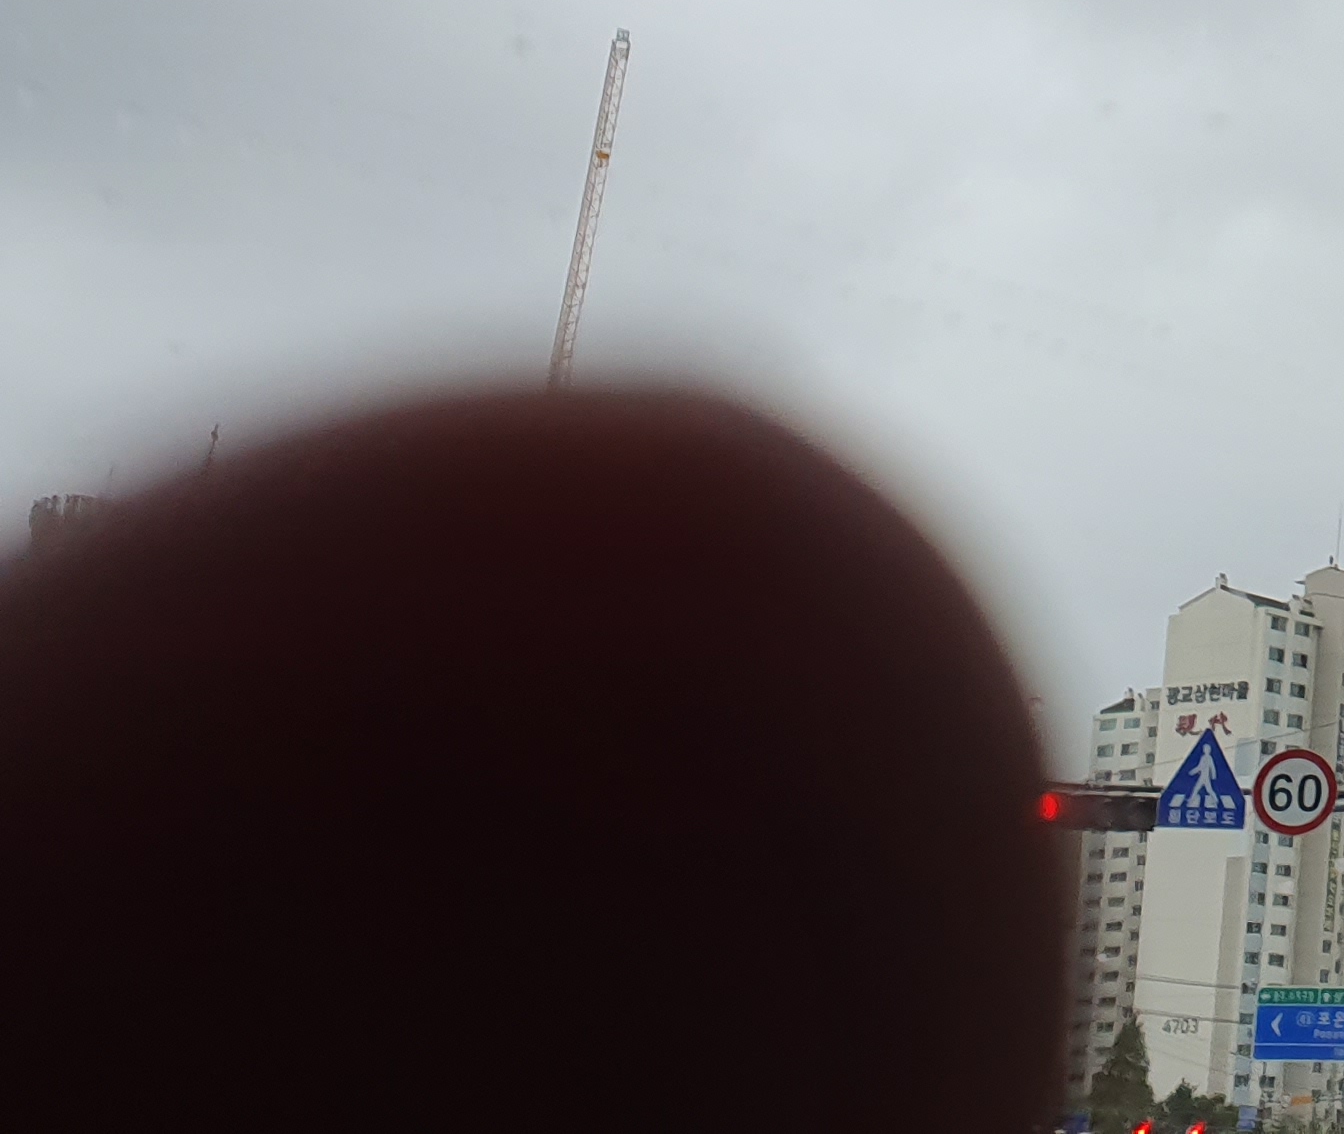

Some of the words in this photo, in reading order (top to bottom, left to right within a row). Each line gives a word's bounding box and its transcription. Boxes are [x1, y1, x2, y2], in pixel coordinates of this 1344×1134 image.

[1268, 773, 1323, 813] 60
[1167, 808, 1236, 825] 횡단보도
[1162, 1017, 1199, 1035] 4703
